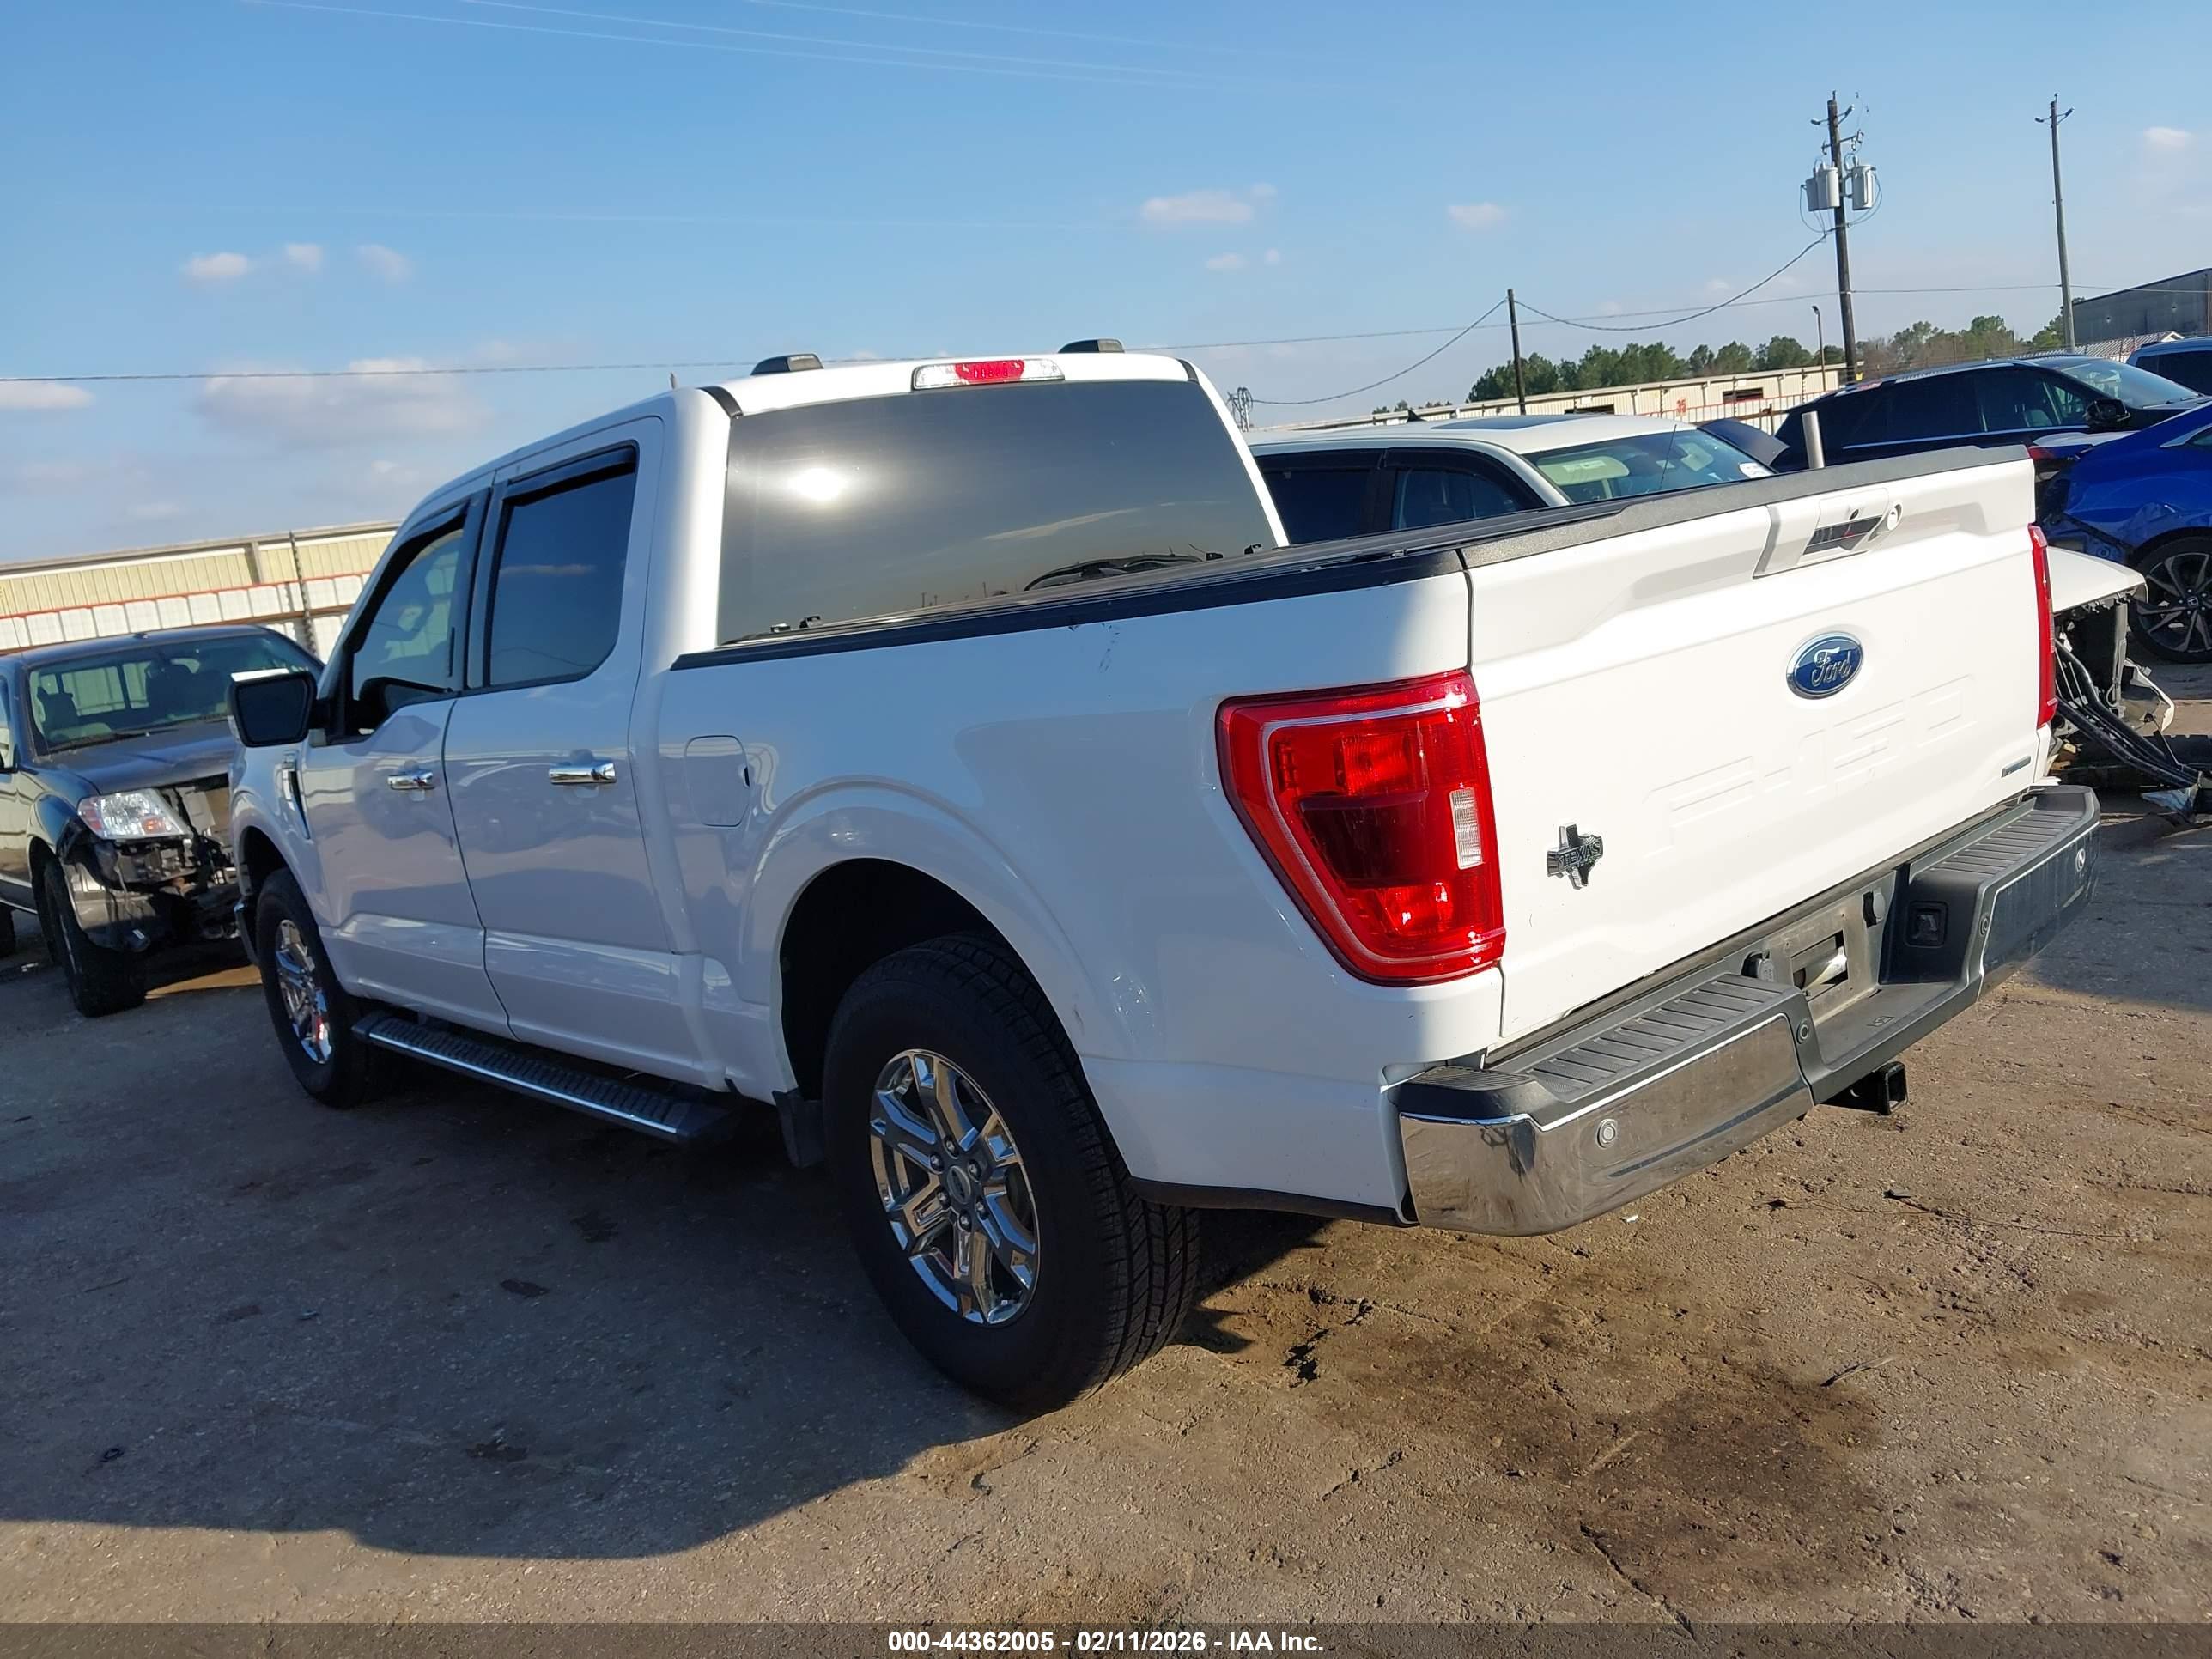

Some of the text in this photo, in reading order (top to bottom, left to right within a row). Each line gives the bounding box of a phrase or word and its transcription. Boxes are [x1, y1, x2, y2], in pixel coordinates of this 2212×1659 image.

[1811, 646, 1853, 688] Ford
[1642, 672, 1978, 859] F-150
[1558, 840, 1601, 867] TEXAS
